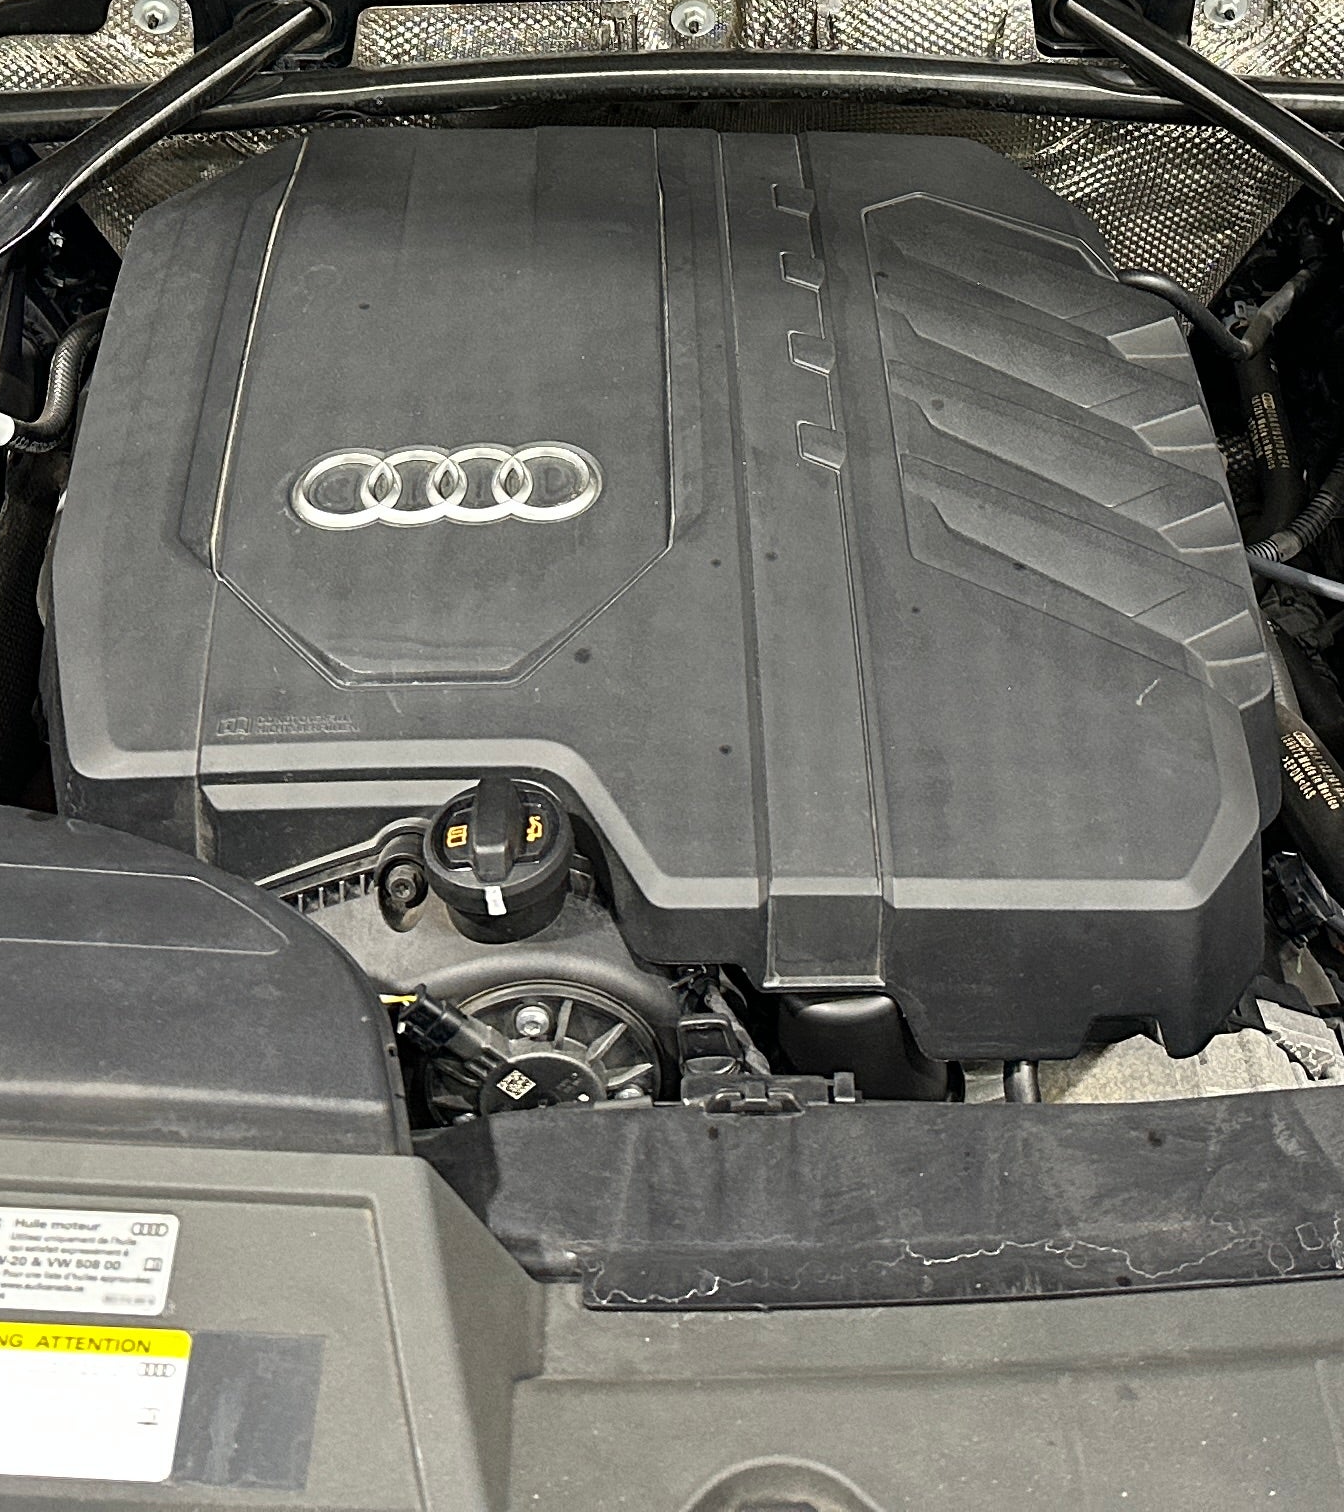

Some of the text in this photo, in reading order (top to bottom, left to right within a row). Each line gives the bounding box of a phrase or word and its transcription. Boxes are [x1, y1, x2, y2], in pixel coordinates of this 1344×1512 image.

[15, 1218, 101, 1231] Huile moteur
[31, 1257, 41, 1267] &
[47, 1257, 72, 1268] VW
[103, 1260, 121, 1271] 00
[35, 1334, 153, 1355] ATTENTION
